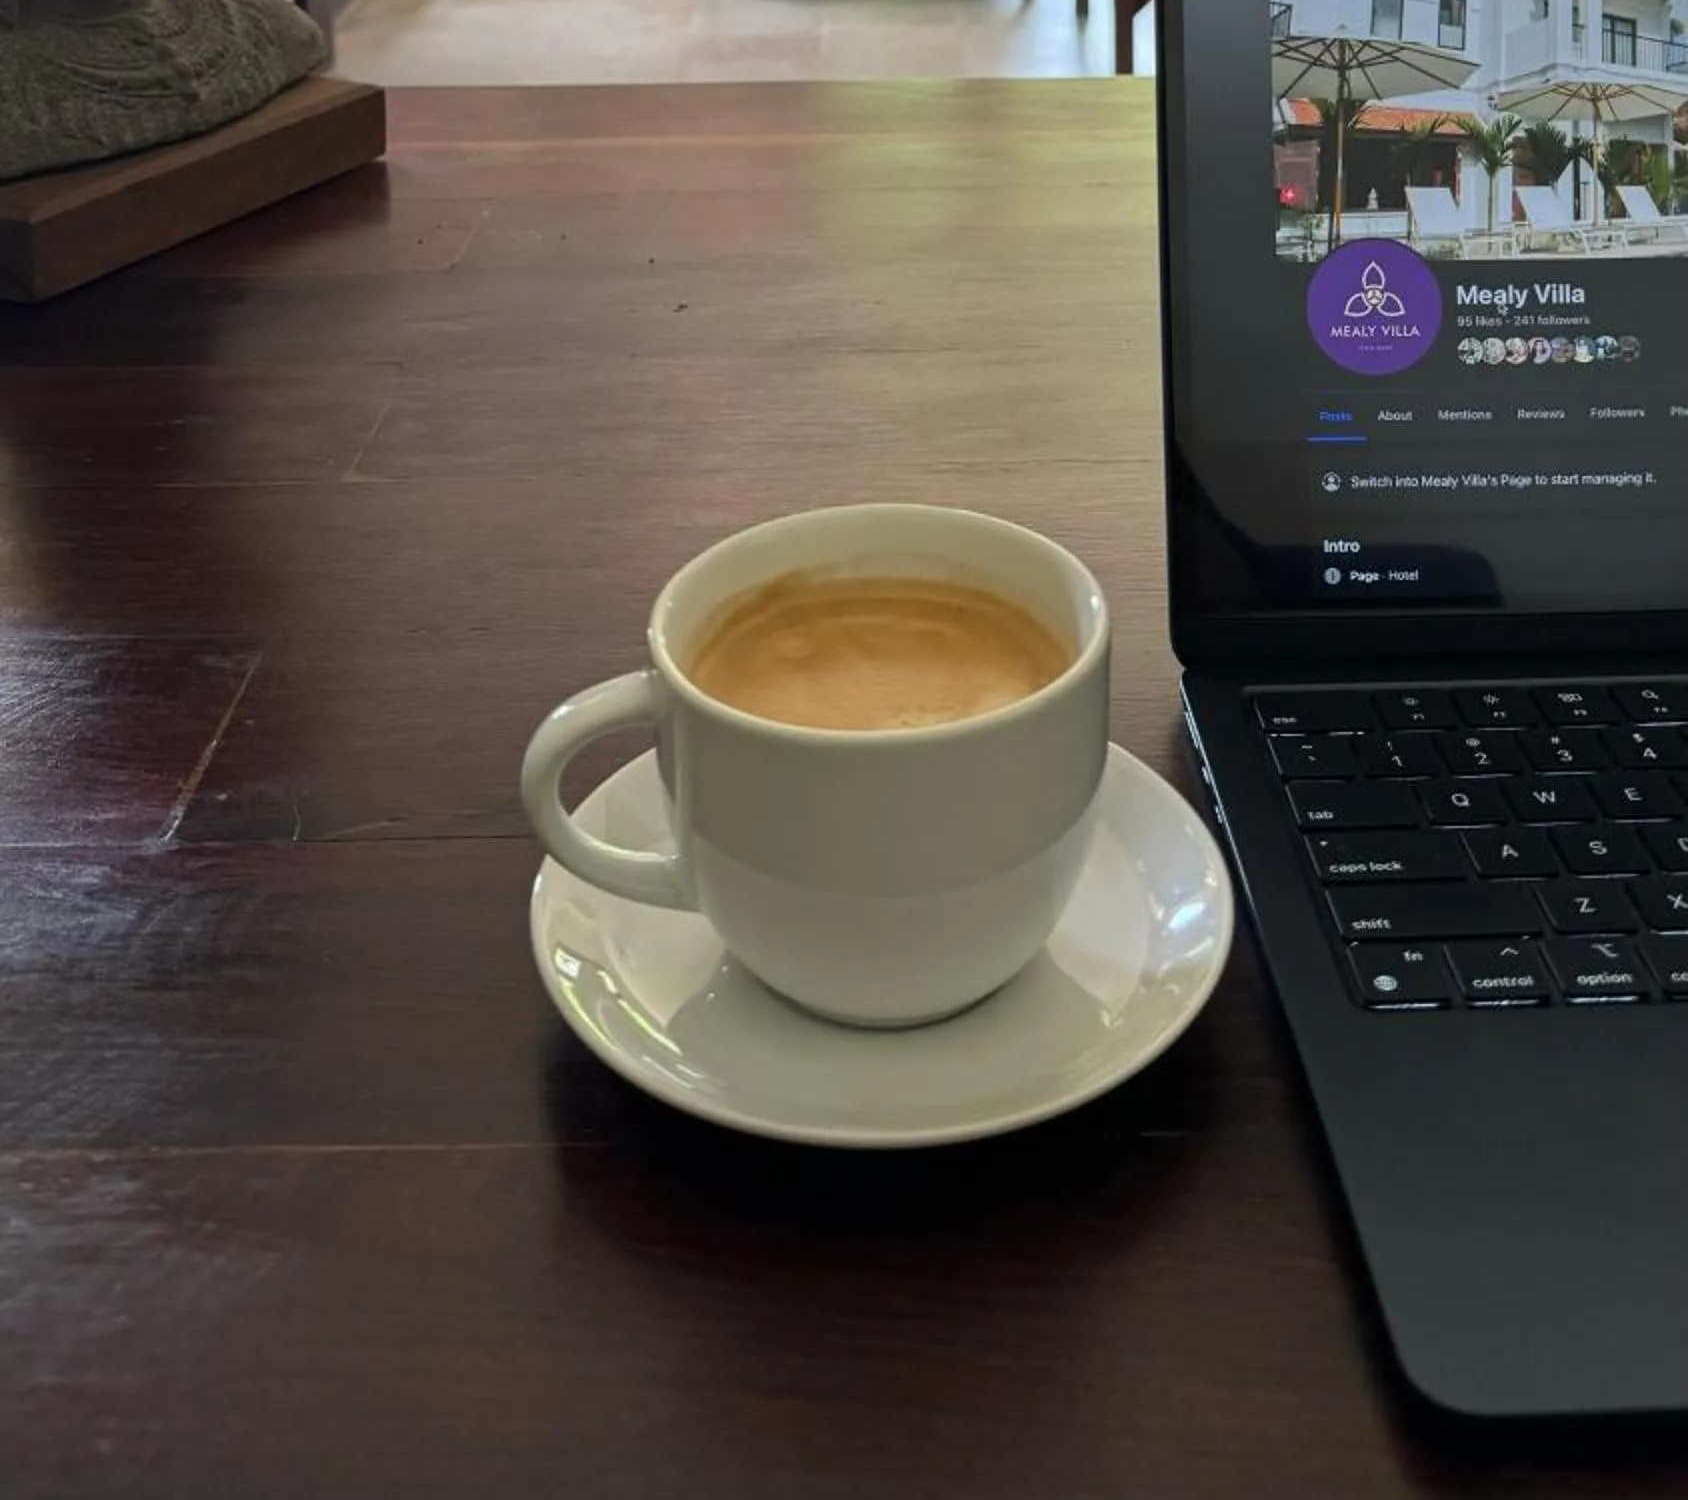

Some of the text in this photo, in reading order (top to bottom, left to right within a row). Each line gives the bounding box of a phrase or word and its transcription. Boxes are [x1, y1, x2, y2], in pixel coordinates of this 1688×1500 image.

[1456, 284, 1586, 309] Mealy Villa
[1475, 315, 1503, 327] likes
[1537, 314, 1591, 325] followers
[1330, 324, 1421, 338] MEALY VILLA
[1319, 411, 1353, 421] Posts
[1377, 410, 1413, 421] About
[1437, 409, 1493, 420] Mentions
[1517, 408, 1566, 419] Reviews
[1589, 407, 1645, 418] Followers
[1351, 472, 1657, 490] Switch into Mealy Villa's Page to start managing it.
[1323, 539, 1361, 553] Intro
[1349, 568, 1419, 583] Page Hotel
[1474, 751, 1491, 766] 2
[1556, 749, 1574, 763] 3
[1451, 792, 1471, 807] Q
[1532, 790, 1556, 804] W
[1623, 787, 1643, 801] E
[1306, 810, 1334, 821] tab
[1501, 843, 1519, 859] A
[1588, 840, 1608, 855] S
[1328, 860, 1403, 874] caps lock
[1573, 897, 1597, 913] Z
[1666, 893, 1688, 909] X
[1351, 917, 1392, 930] shift
[1403, 950, 1424, 962] fn
[1472, 975, 1534, 988] control
[1576, 971, 1633, 985] option
